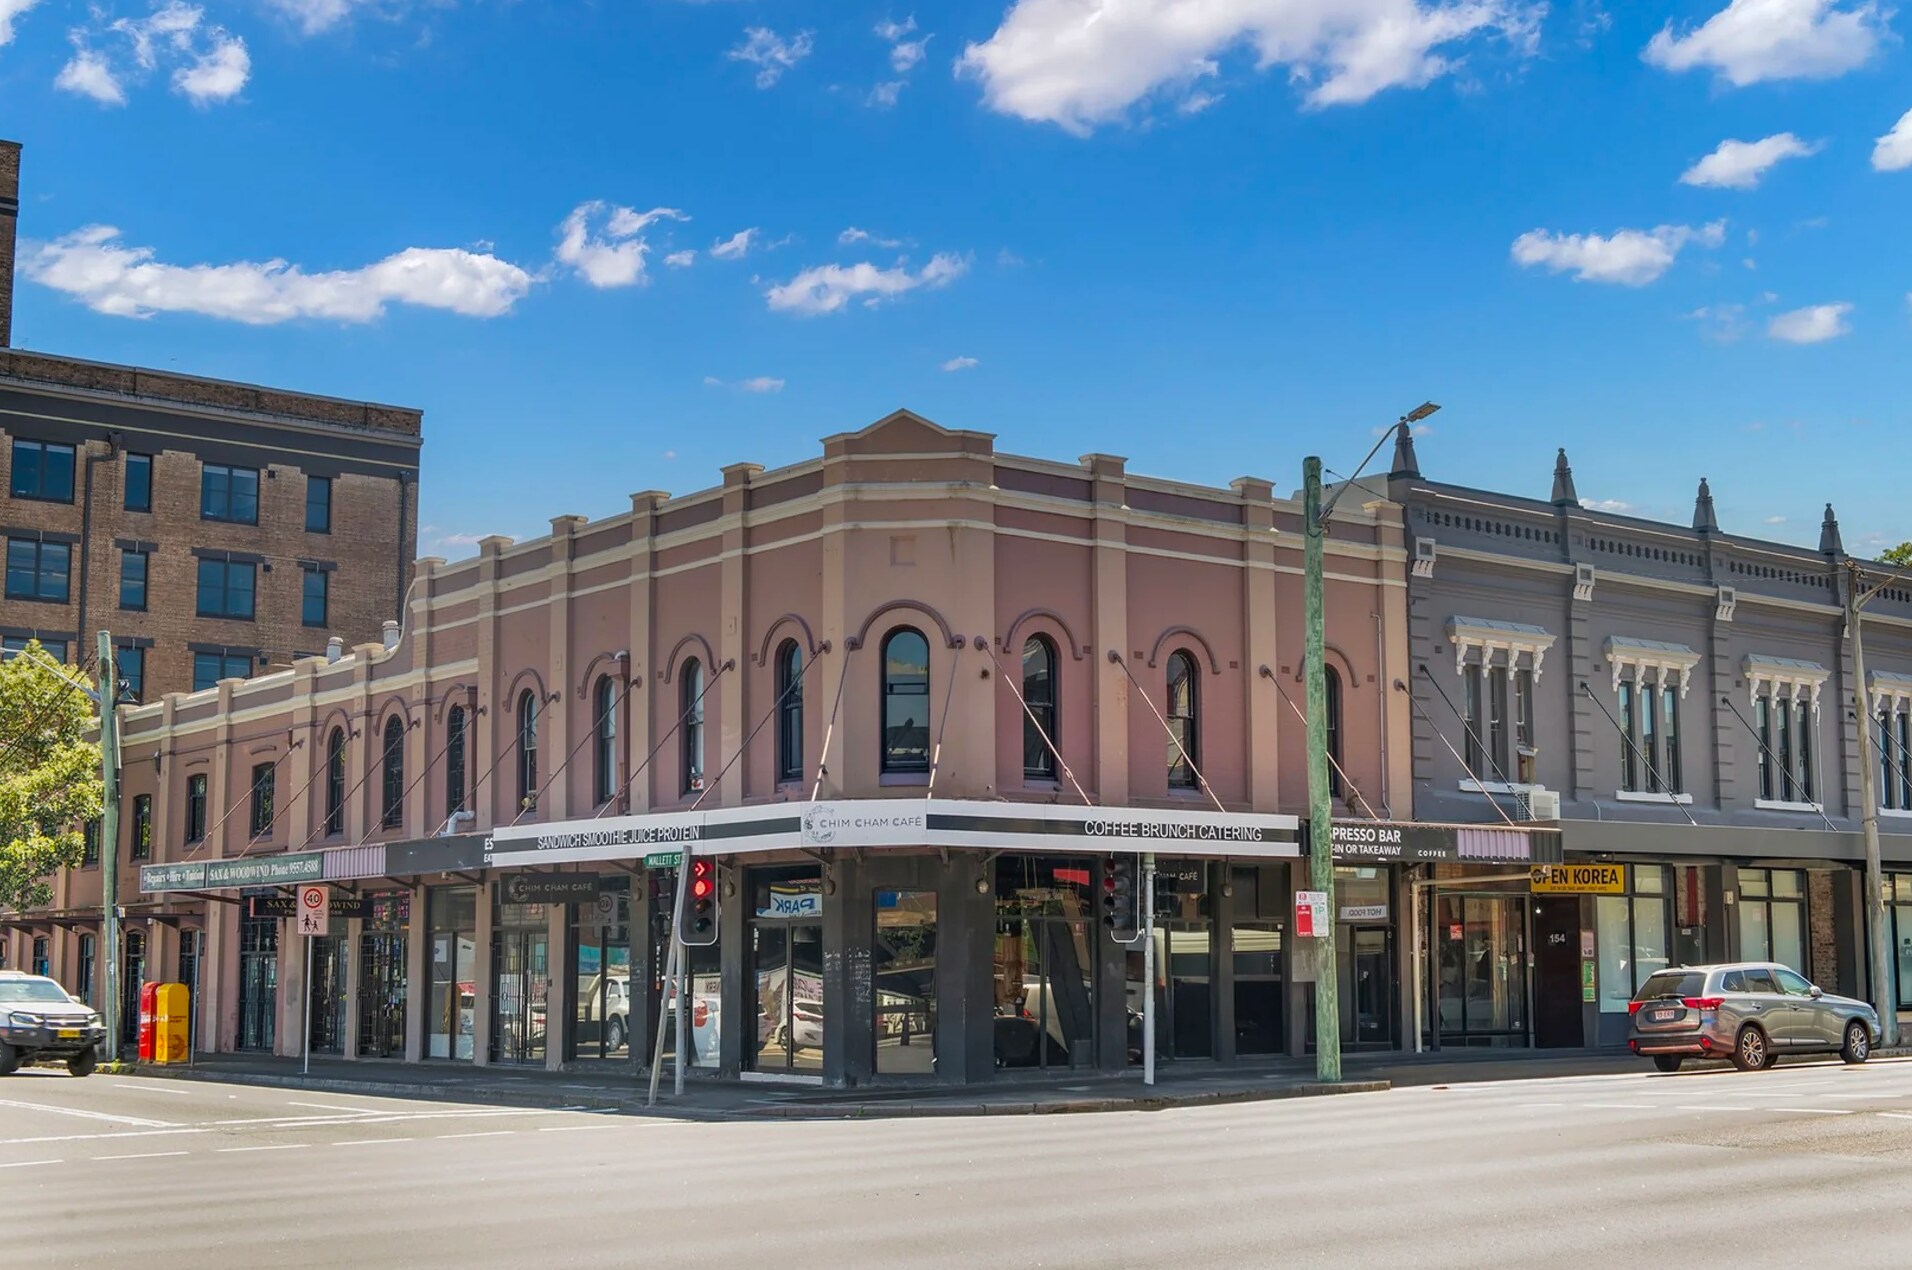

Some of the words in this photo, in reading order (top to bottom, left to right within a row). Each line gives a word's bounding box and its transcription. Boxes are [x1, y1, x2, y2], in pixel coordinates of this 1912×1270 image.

[820, 819, 850, 828] CHIM
[855, 818, 888, 827] CHAM
[892, 815, 922, 826] CAFÉ
[1084, 821, 1138, 837] COFFEE
[1141, 822, 1196, 838] BRUNCH
[1199, 824, 1262, 841] CATERING
[1331, 827, 1376, 842] PRESSO
[1379, 829, 1401, 843] BAR
[537, 834, 581, 850] SANDWICH
[582, 830, 627, 847] SMOOTHIE
[629, 827, 655, 843] JUICE
[657, 825, 700, 842] PROTEIN
[1345, 844, 1358, 854] OR
[1358, 844, 1401, 856] TAKEAWAY
[1417, 849, 1447, 858] COFFEE
[648, 854, 672, 866] MALLETT
[146, 871, 167, 886] Repairs
[169, 870, 182, 882] Hire
[186, 869, 204, 881] Tuition
[209, 868, 223, 881] SAX
[229, 864, 270, 879] WOODWIND
[270, 863, 289, 876] Phone
[1179, 870, 1198, 881] CAFÉ
[1573, 868, 1619, 884] KOREA
[519, 884, 541, 892] CHIM
[544, 883, 568, 892] CHAM
[266, 900, 287, 908] SAX
[306, 893, 319, 903] 40
[1549, 933, 1566, 943] 154
